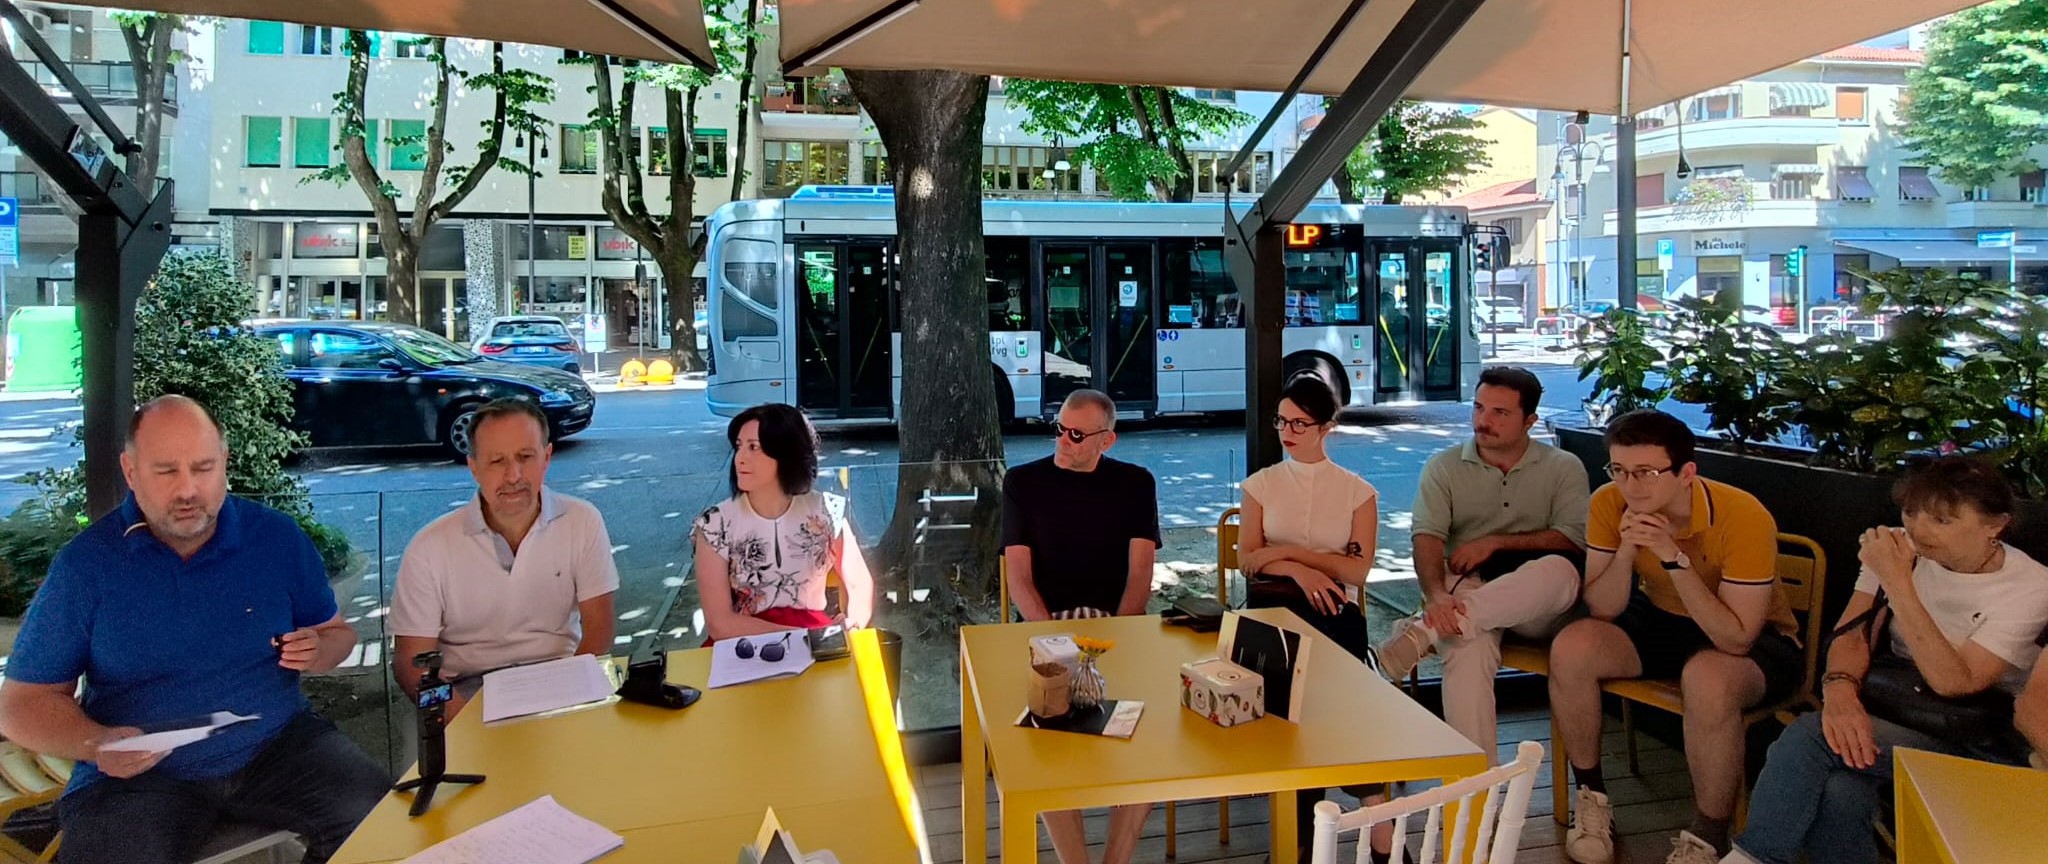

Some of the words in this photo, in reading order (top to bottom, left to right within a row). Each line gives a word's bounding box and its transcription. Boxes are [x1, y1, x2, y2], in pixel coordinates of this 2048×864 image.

[1289, 225, 1319, 245] LP
[603, 238, 634, 252] ubik
[1661, 241, 1670, 254] P
[1695, 240, 1746, 250] Michele
[992, 346, 1007, 357] fvg
